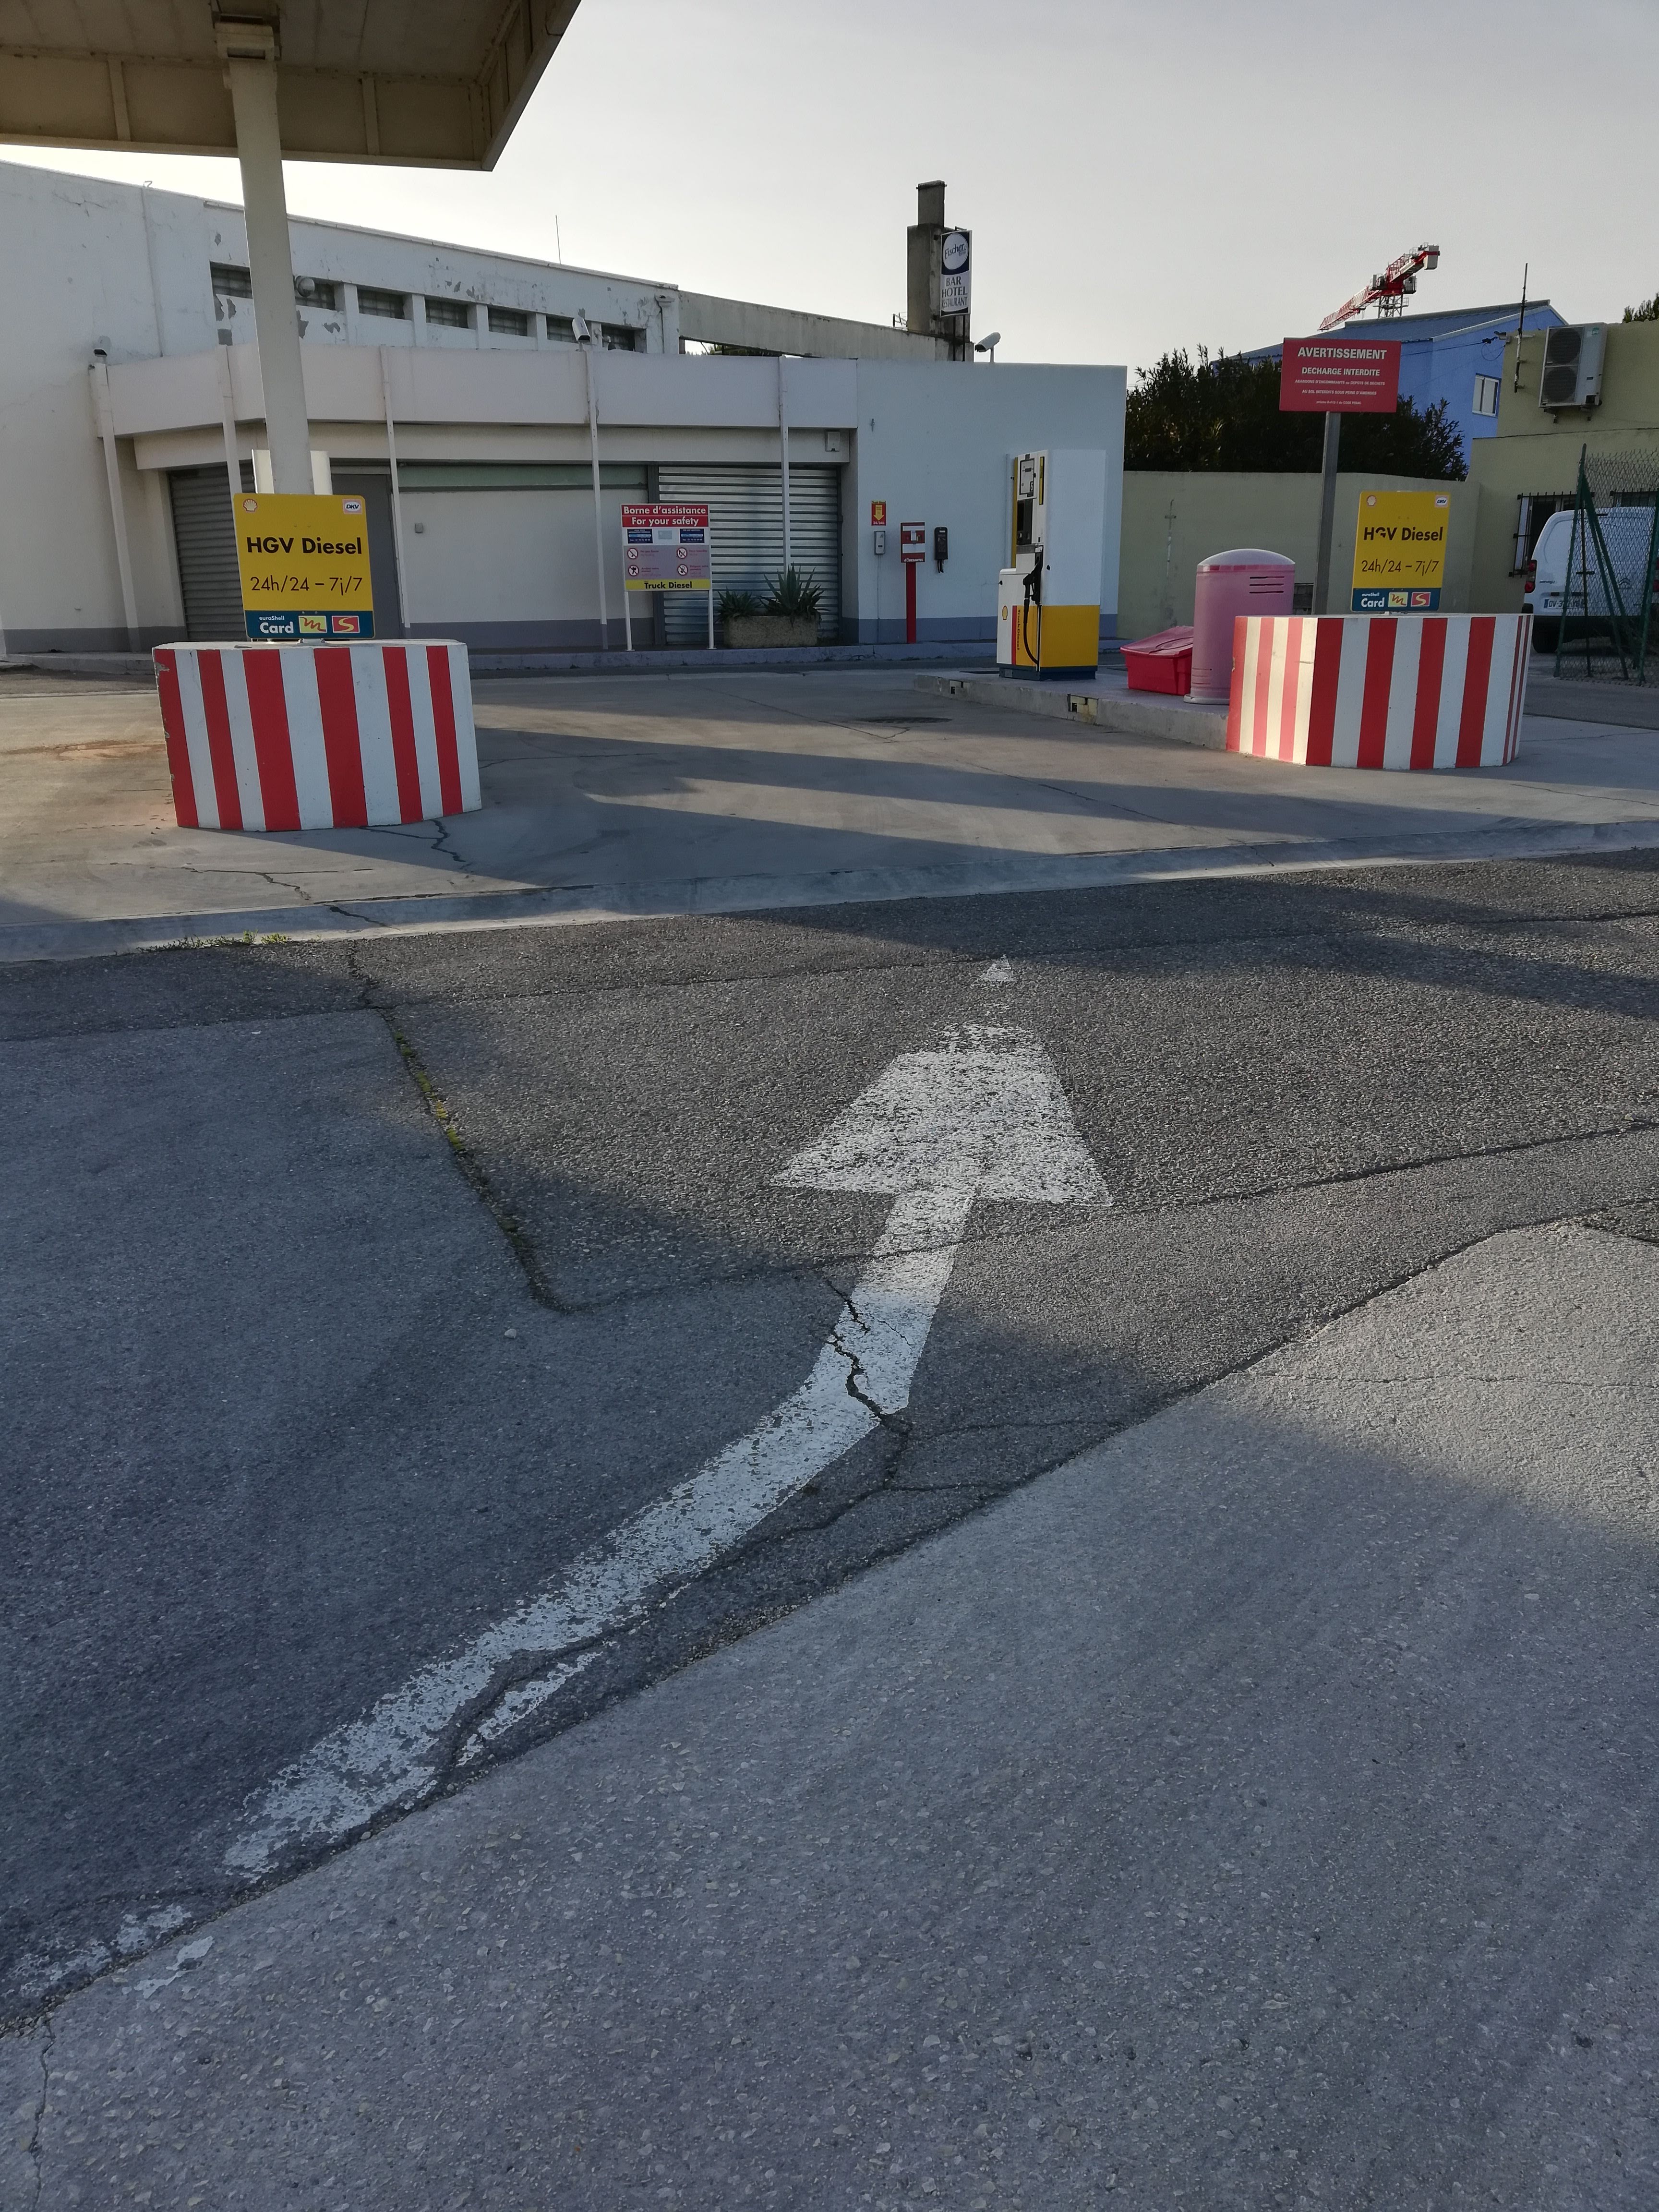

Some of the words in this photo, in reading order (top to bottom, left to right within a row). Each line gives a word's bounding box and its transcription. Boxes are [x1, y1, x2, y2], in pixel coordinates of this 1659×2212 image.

[946, 276, 962, 287] BAR
[942, 286, 968, 298] HOTEL
[942, 296, 968, 308] RESTAURANT
[1298, 347, 1387, 359] AVERTISSEMENT
[652, 506, 706, 514] d'assistance
[673, 517, 698, 526] safety
[1401, 527, 1443, 541] Diesel
[246, 537, 294, 553] HGV
[302, 537, 362, 554] Diesel
[1361, 559, 1401, 574] 24h/24
[1415, 560, 1439, 576] 7j/7
[250, 575, 310, 592] 24h/24
[329, 576, 362, 595] 7j/7
[1361, 597, 1384, 607] Card
[260, 622, 294, 634] Card
